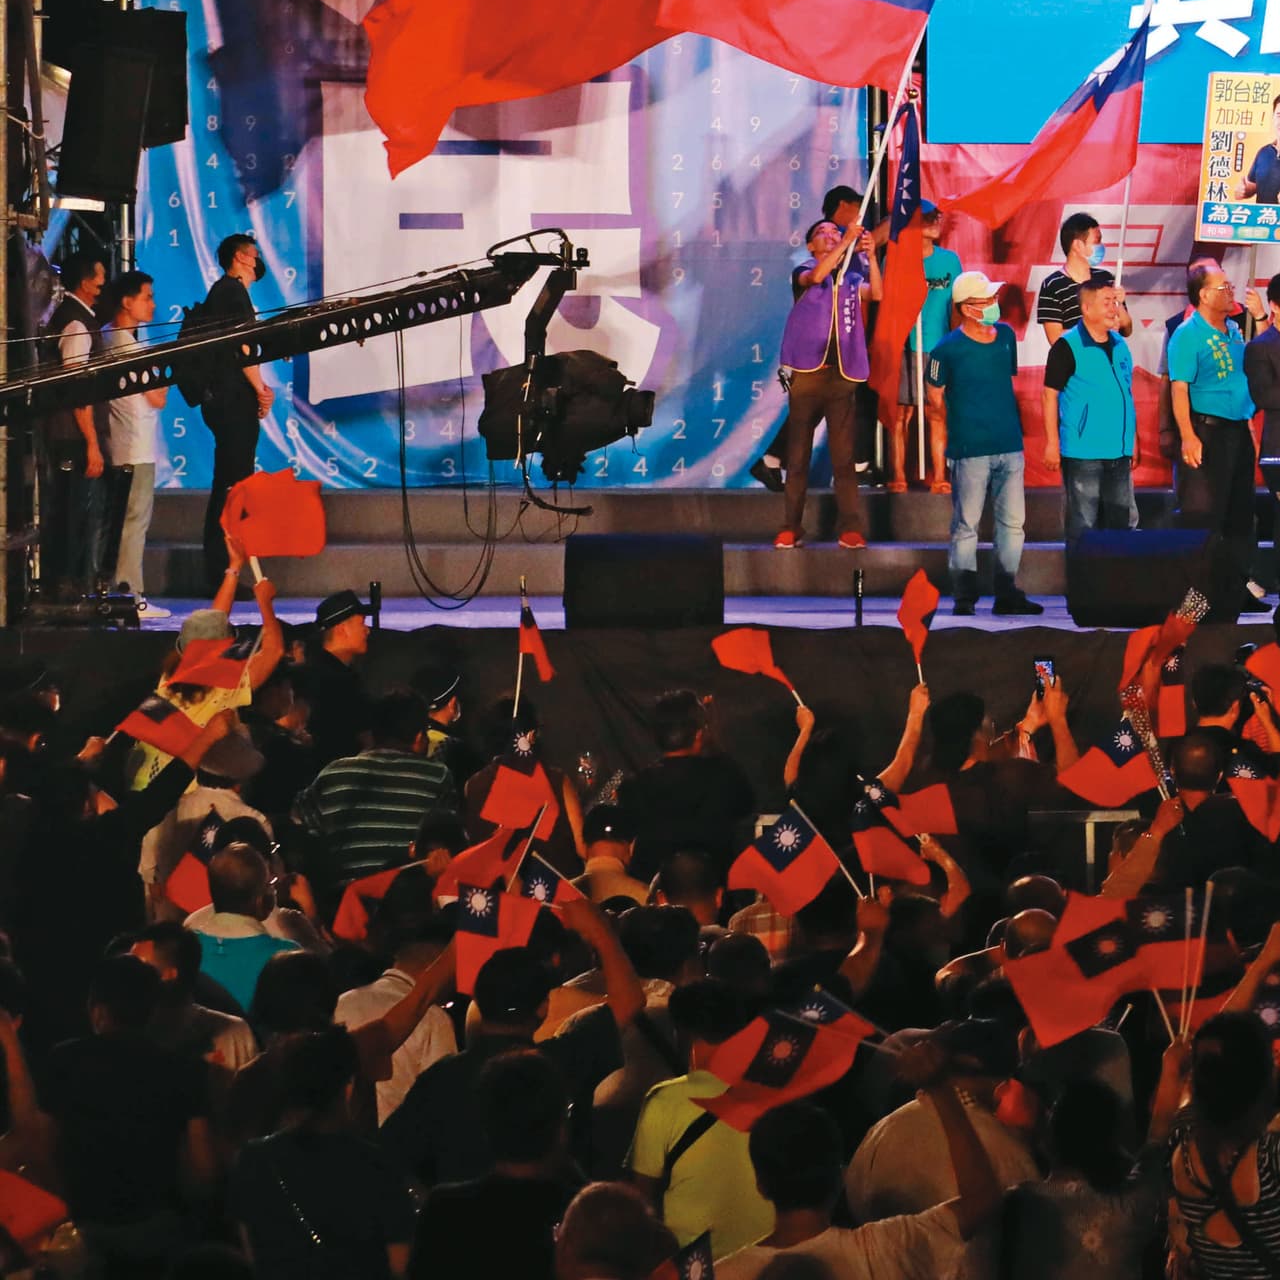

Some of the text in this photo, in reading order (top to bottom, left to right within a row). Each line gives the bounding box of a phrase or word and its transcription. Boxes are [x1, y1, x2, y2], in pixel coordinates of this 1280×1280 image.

[207, 78, 219, 92] 4
[828, 80, 839, 94] 2
[1215, 79, 1271, 104] 郭台銘
[207, 115, 218, 131] 8
[207, 153, 218, 168] 4
[1207, 130, 1233, 202] 劉德林
[169, 191, 295, 208] 6 1 7
[1208, 205, 1251, 224] 為台
[169, 229, 179, 246] 1
[284, 268, 296, 285] 9
[168, 305, 182, 322] 2
[752, 344, 763, 362] 1
[712, 380, 764, 400] 1 5
[174, 418, 186, 437] 5
[285, 419, 298, 439] 8
[324, 420, 337, 439] 4
[403, 420, 417, 440] 3
[673, 420, 686, 439] 2
[712, 419, 725, 438] 7
[174, 455, 457, 478] 2 3 5 2 3
[595, 456, 608, 477] 2
[633, 457, 648, 476] 4
[672, 456, 686, 476] 4
